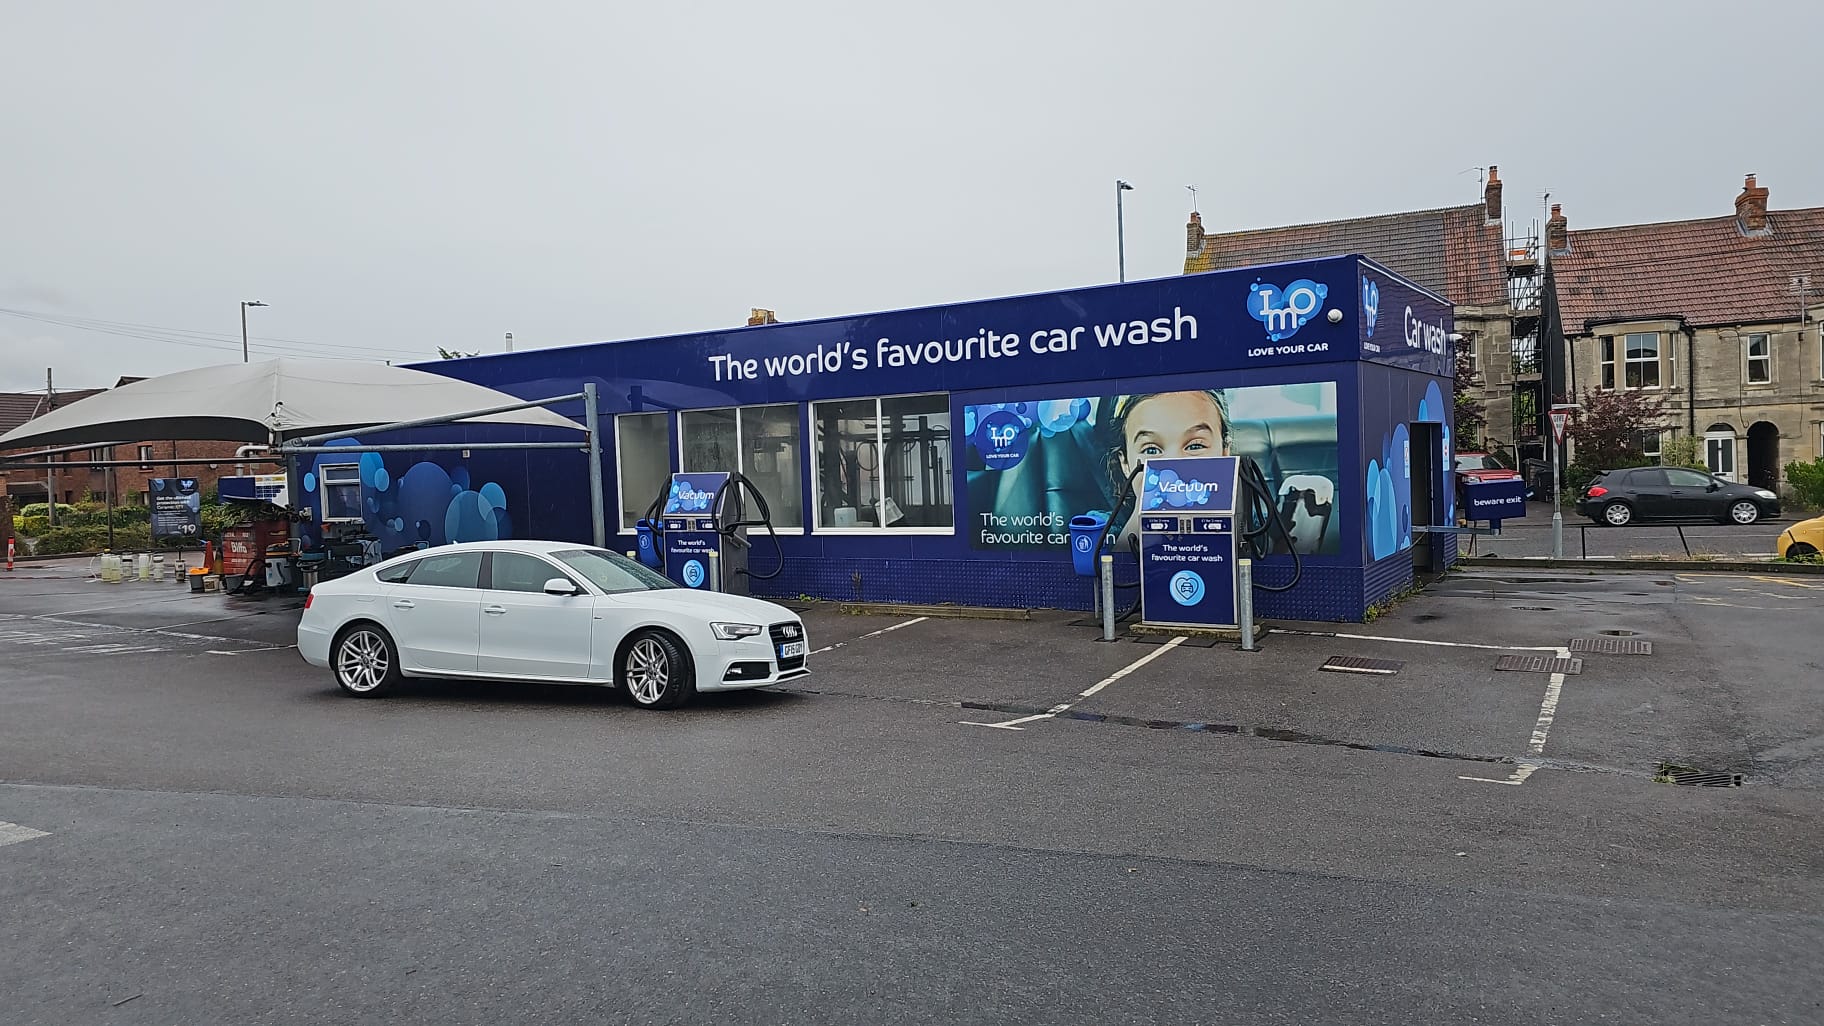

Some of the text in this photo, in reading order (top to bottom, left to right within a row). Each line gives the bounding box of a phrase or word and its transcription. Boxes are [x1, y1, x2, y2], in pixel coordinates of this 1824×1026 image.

[1404, 305, 1447, 356] Car wash
[708, 306, 1198, 381] The world's favourite car wash
[1248, 342, 1329, 357] LOVE YOUR CAR
[1158, 481, 1218, 492] Vacuum
[678, 490, 714, 500] Vacuum
[1473, 496, 1522, 506] beware exit
[980, 511, 1064, 527] The world's
[981, 529, 1044, 544] favourite
[1047, 533, 1071, 544] car
[1162, 544, 1208, 552] The world's
[1151, 554, 1186, 562] favourite
